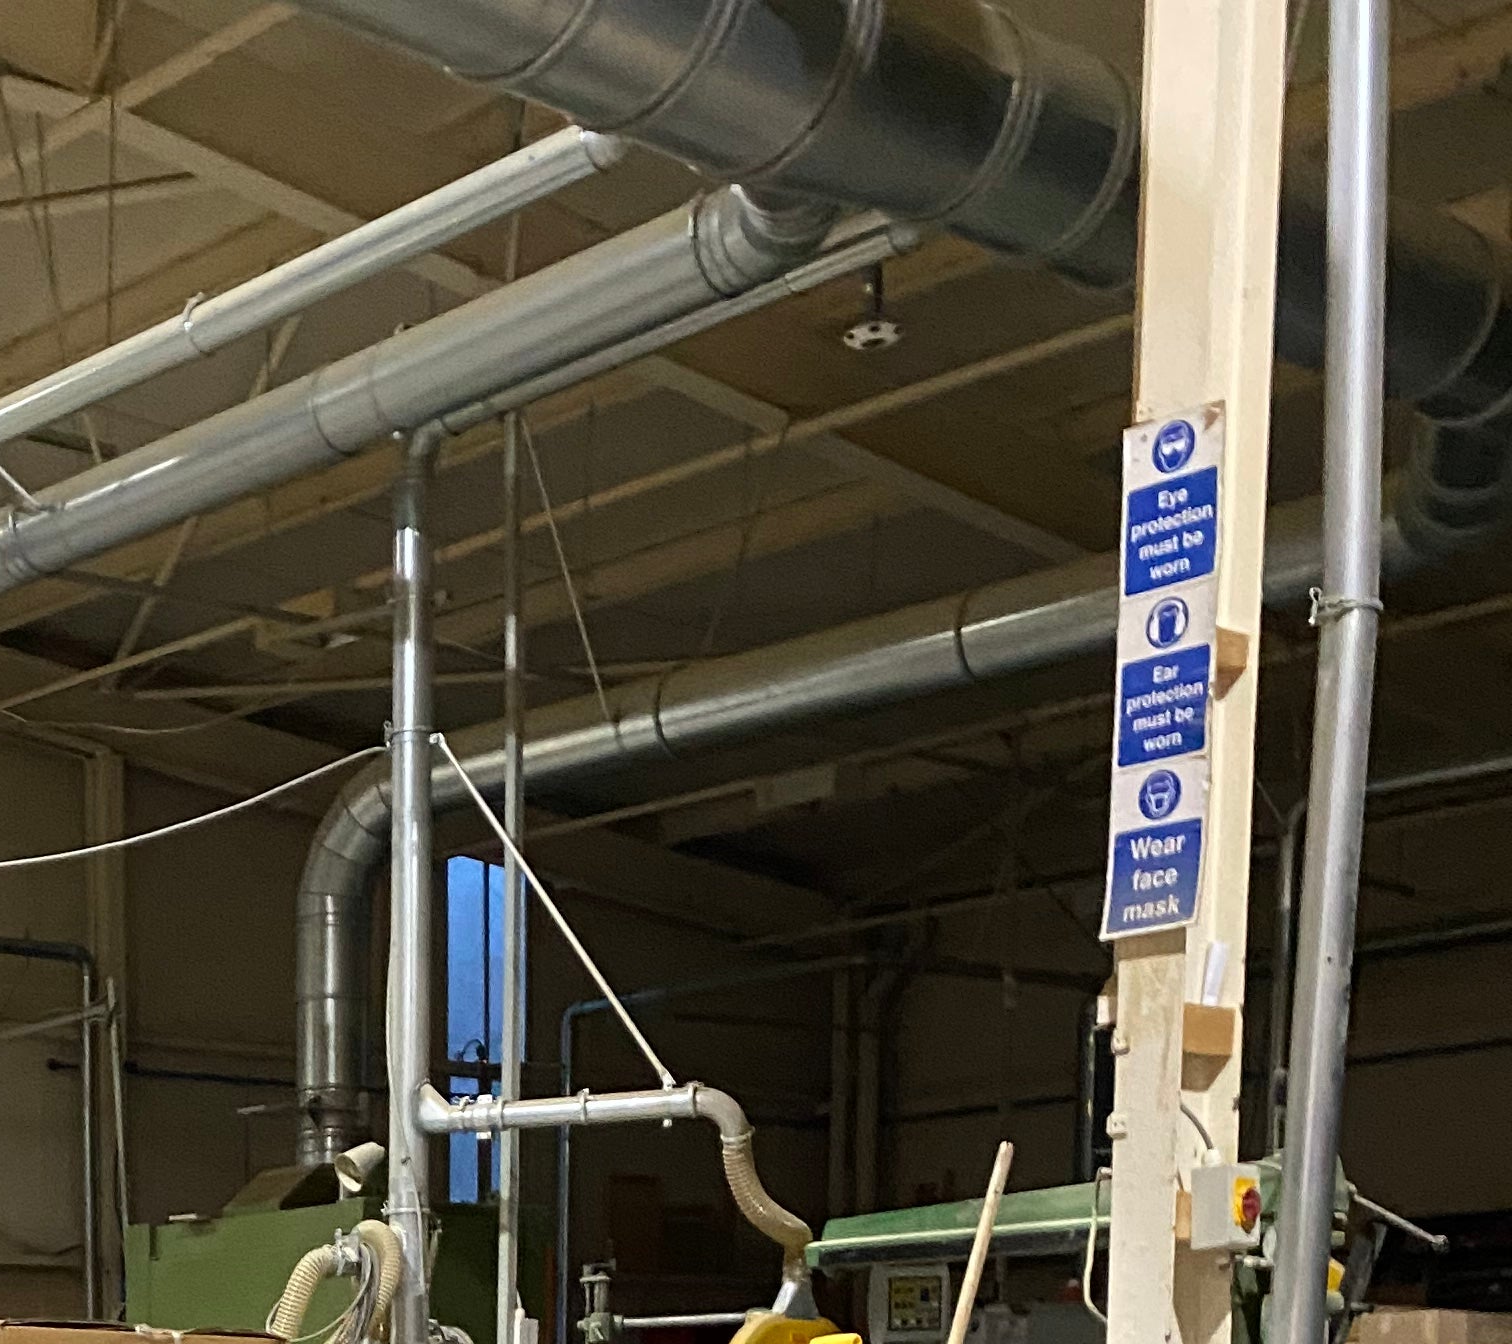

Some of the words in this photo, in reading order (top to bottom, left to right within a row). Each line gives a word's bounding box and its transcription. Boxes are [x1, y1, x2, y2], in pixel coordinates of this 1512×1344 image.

[1158, 488, 1187, 509] Eye
[1131, 503, 1214, 542] protection
[1139, 535, 1178, 560] must
[1183, 529, 1204, 548] be
[1150, 557, 1190, 579] worn
[1153, 664, 1180, 684] Ear
[1126, 681, 1204, 716] protection
[1133, 710, 1171, 731] must
[1175, 705, 1194, 723] be
[1144, 731, 1182, 751] worn
[1130, 833, 1186, 860] Wear
[1132, 867, 1178, 891] face
[1123, 894, 1180, 922] mask
